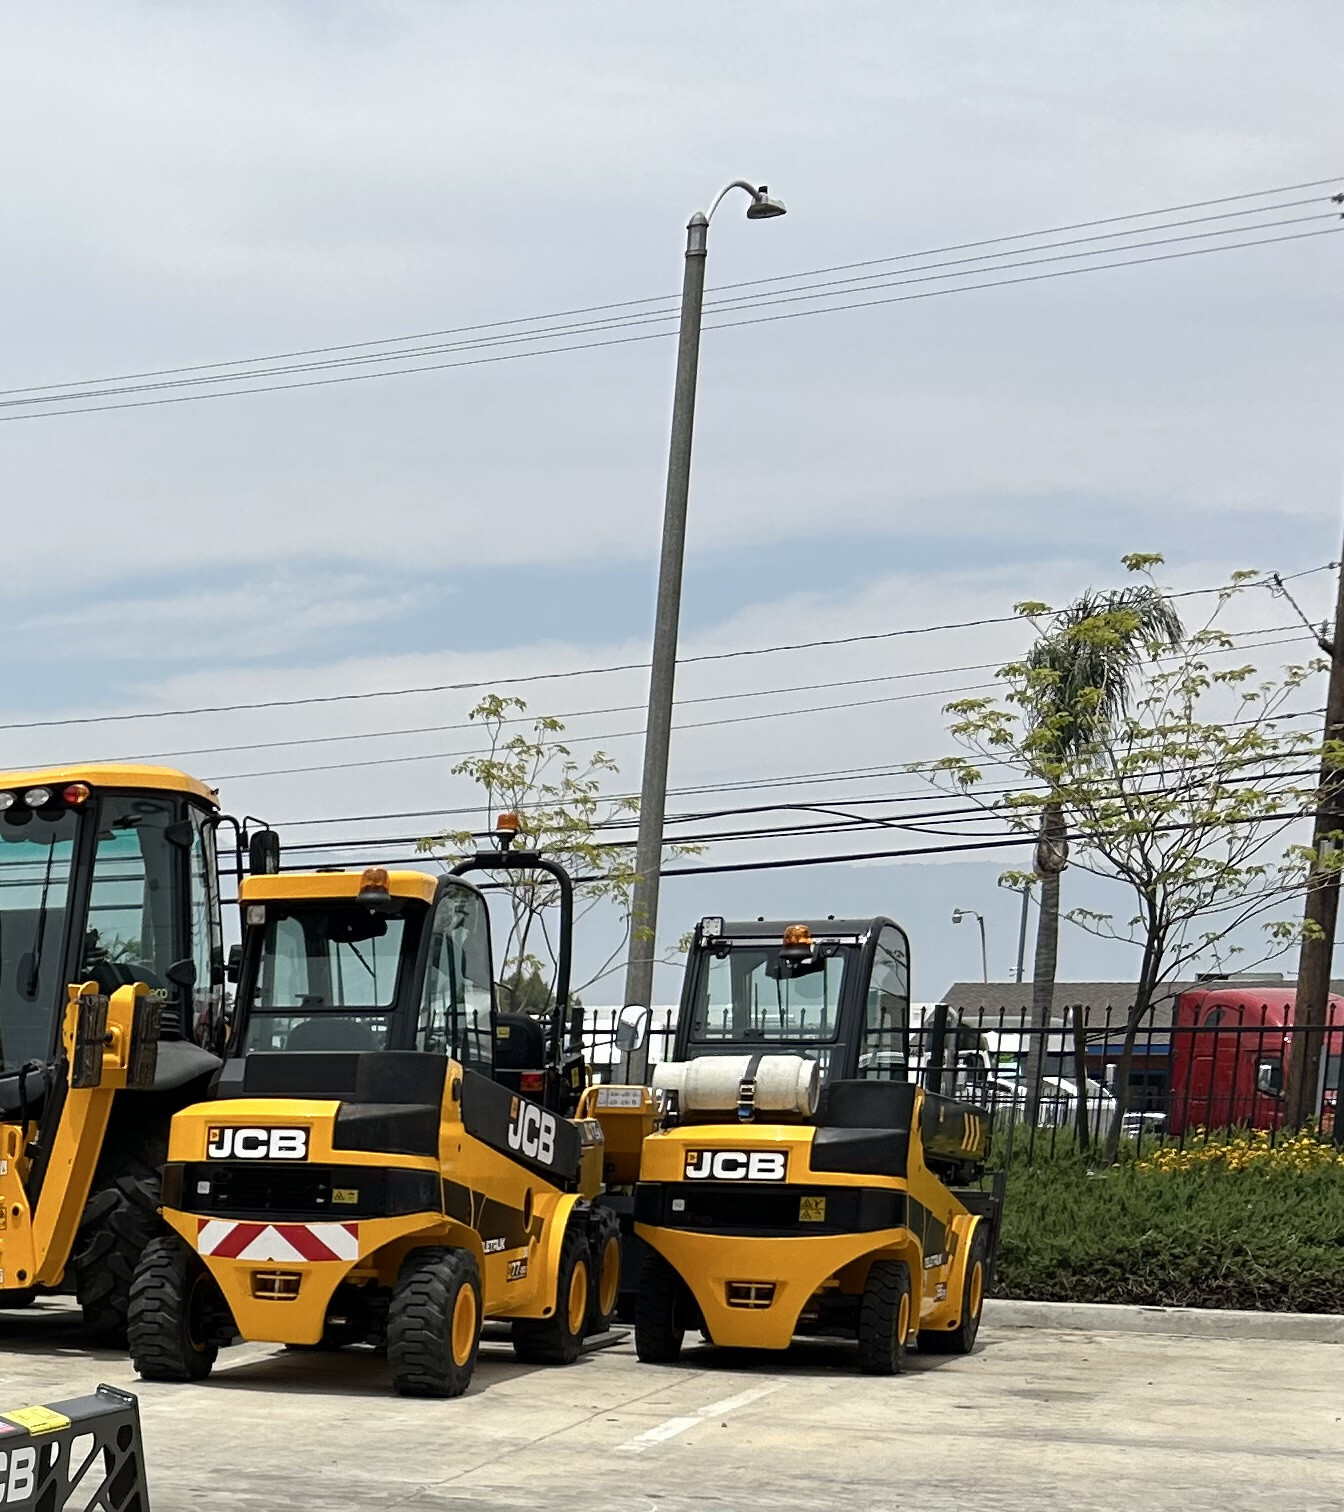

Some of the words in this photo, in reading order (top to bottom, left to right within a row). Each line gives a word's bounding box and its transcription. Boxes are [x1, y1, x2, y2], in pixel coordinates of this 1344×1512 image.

[208, 1129, 306, 1158] JCB
[508, 1100, 556, 1165] JCB
[686, 1152, 785, 1180] JCB
